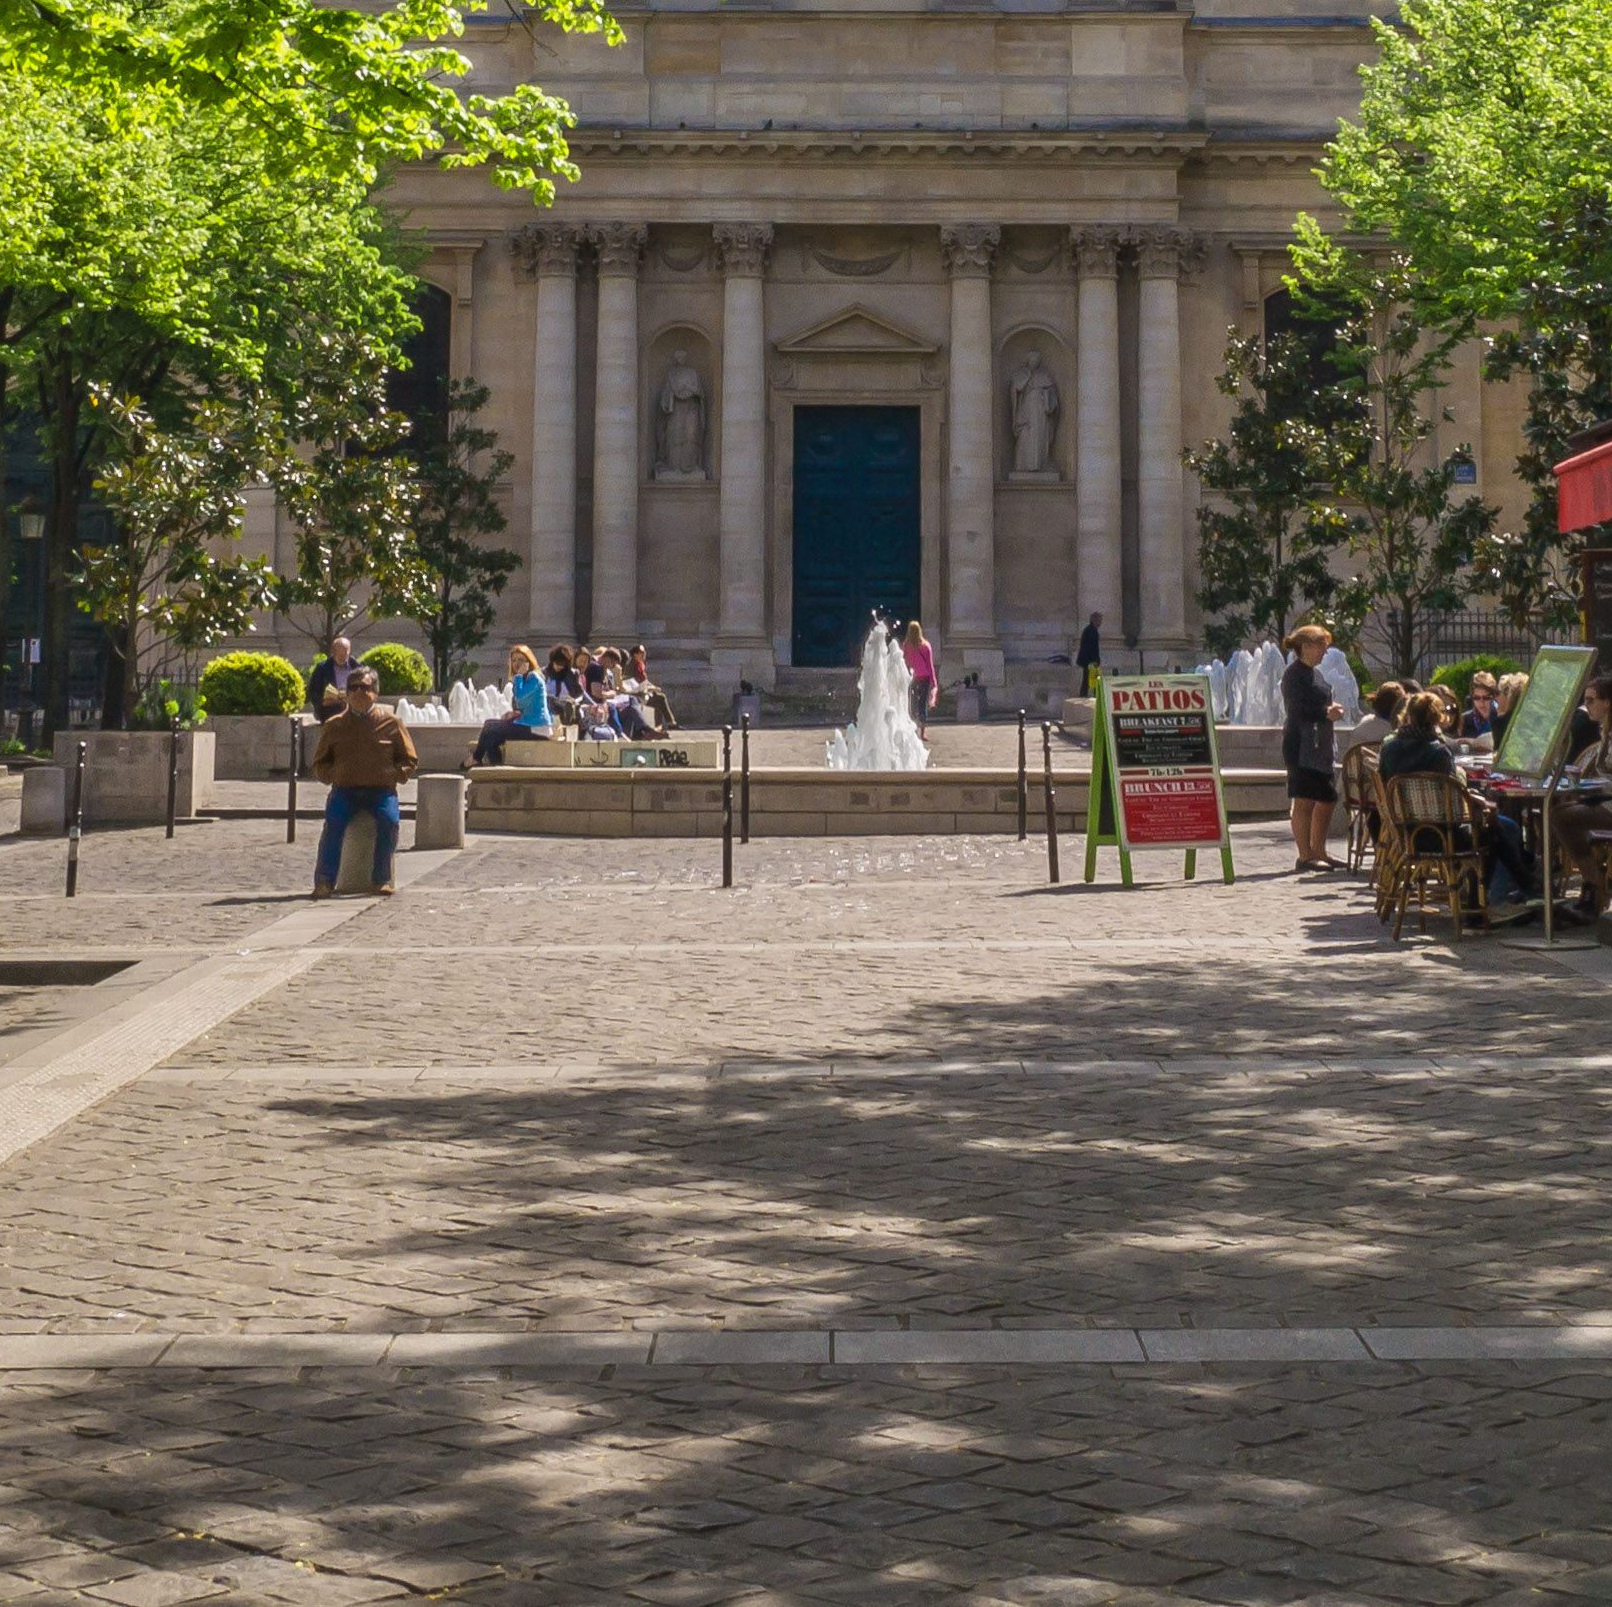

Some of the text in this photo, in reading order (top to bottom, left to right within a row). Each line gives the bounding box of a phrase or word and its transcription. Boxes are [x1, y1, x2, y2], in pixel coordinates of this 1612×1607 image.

[1112, 689, 1205, 711] PATIOS
[1119, 718, 1178, 727] BREAKFAST
[1125, 783, 1182, 793] BRUNCH
